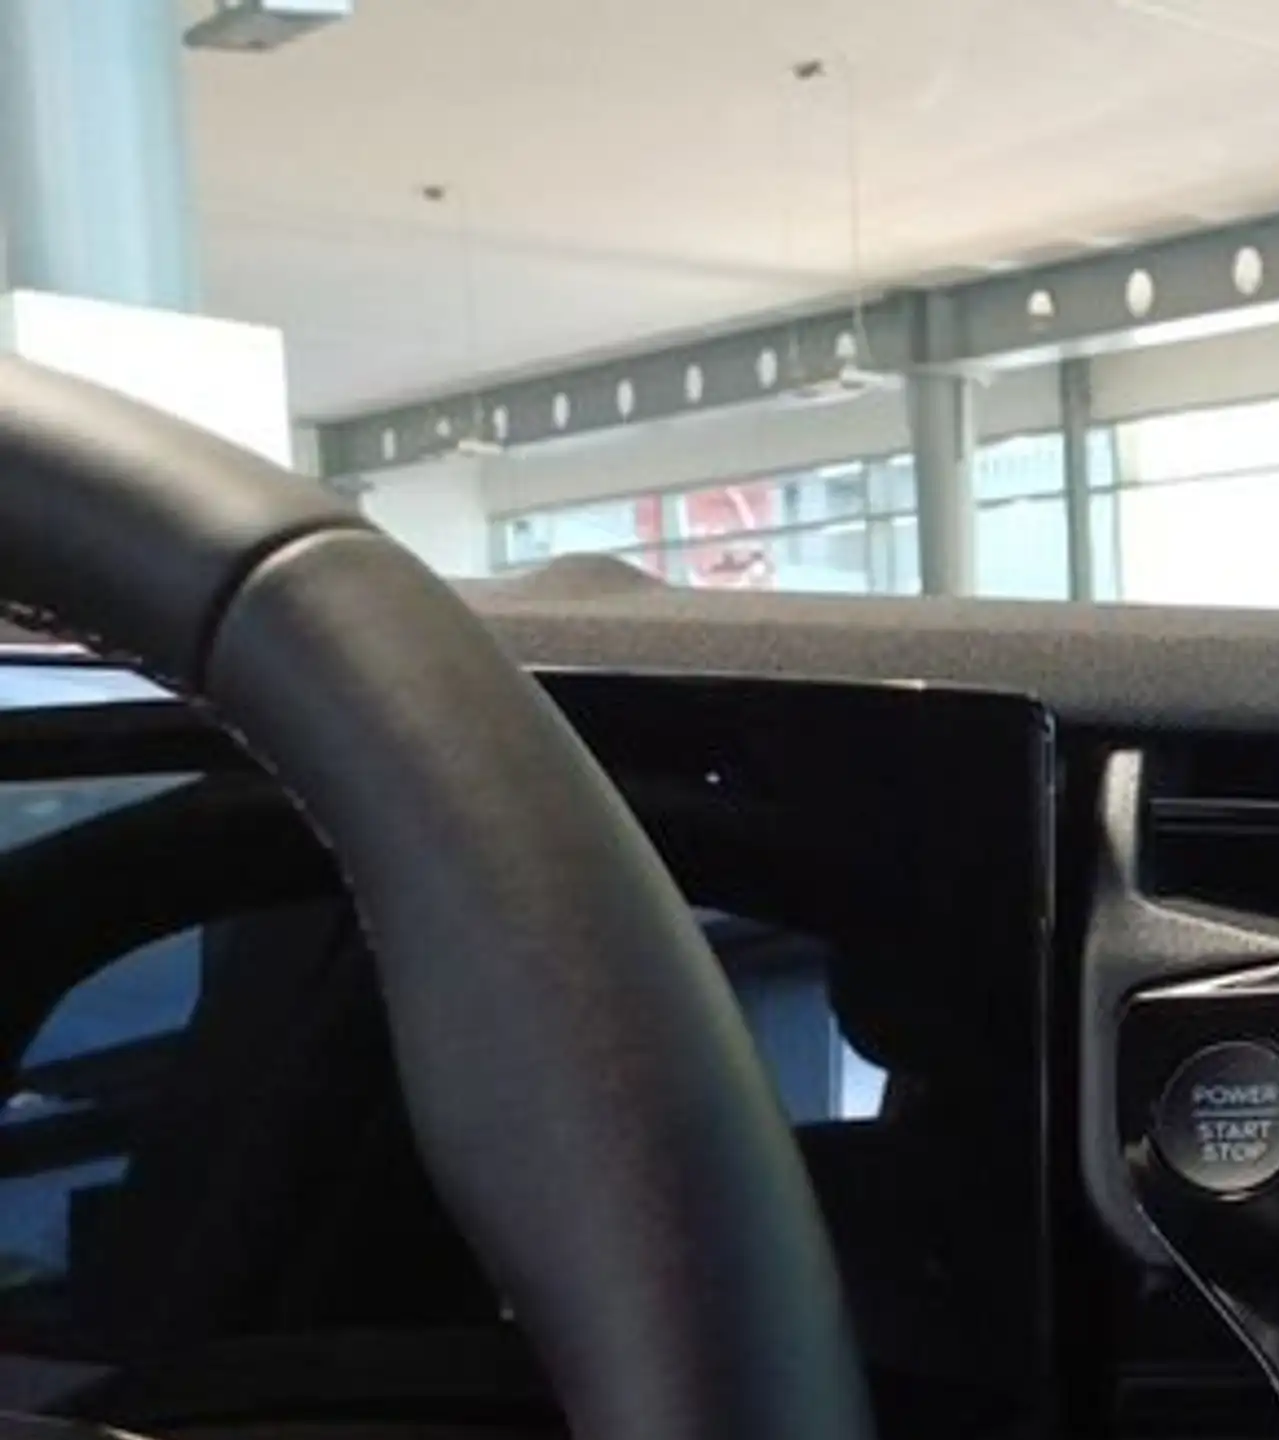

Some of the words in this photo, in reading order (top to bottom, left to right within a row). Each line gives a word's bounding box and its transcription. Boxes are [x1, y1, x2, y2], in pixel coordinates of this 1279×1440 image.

[1191, 1083, 1279, 1104] POWER
[1197, 1121, 1271, 1141] START
[1202, 1142, 1268, 1162] STOP
